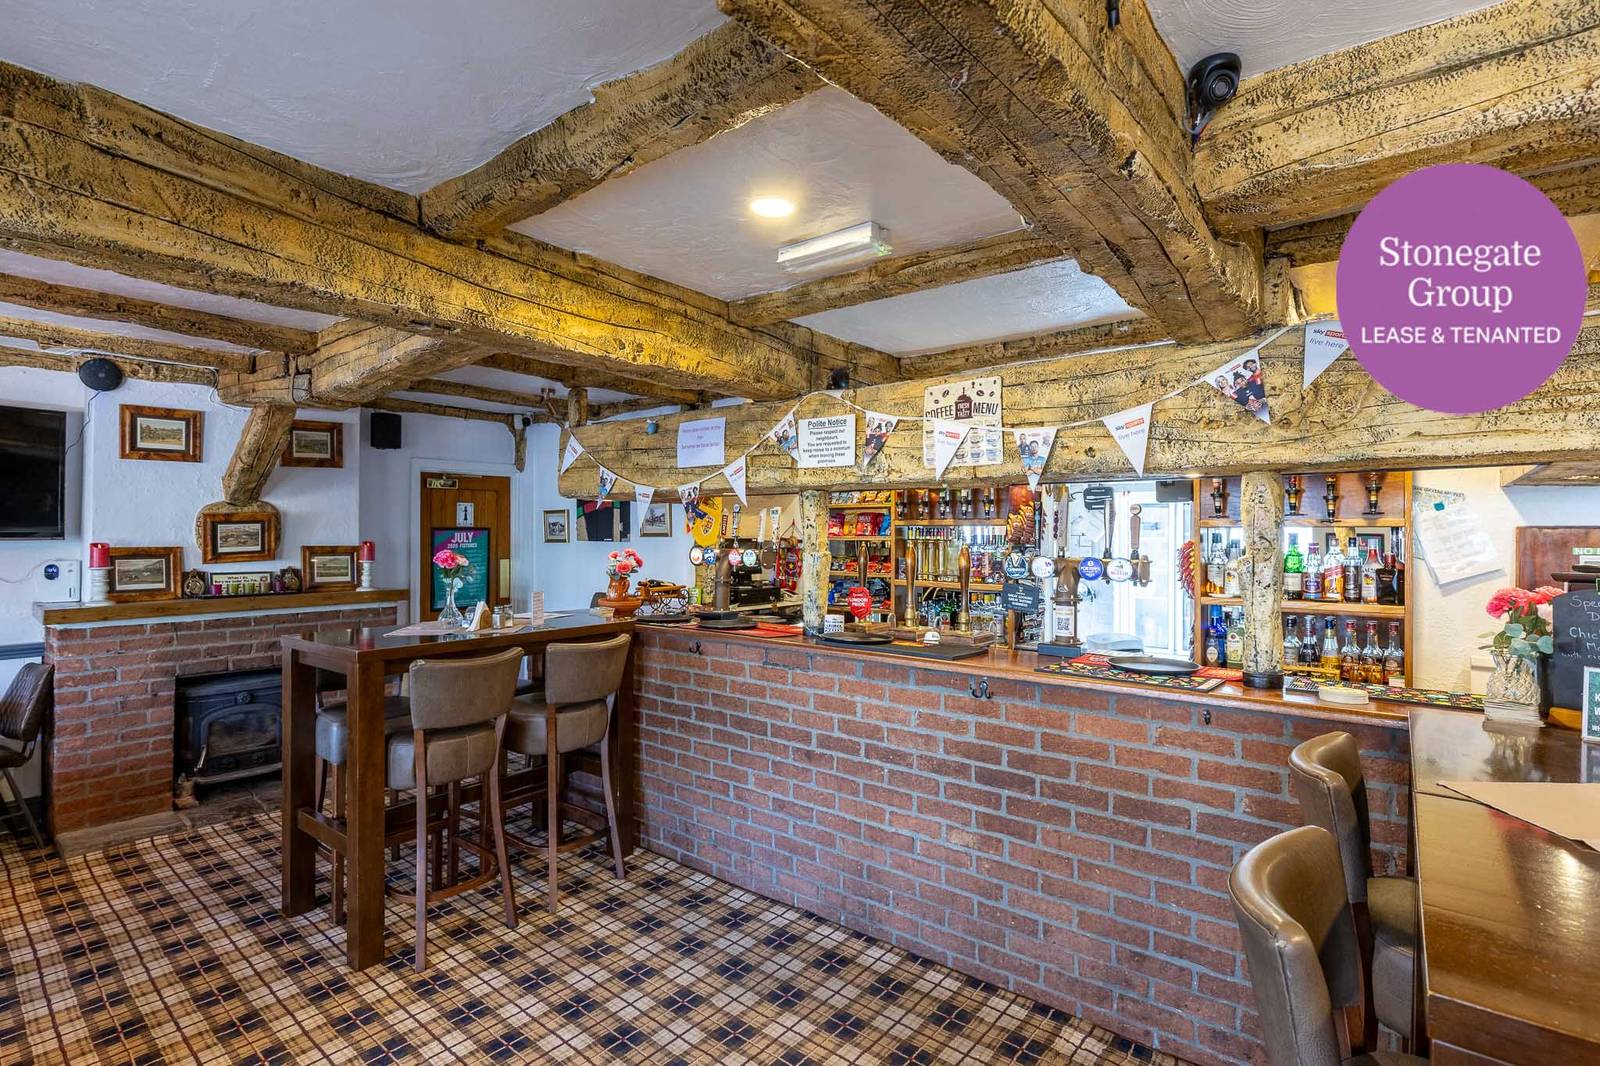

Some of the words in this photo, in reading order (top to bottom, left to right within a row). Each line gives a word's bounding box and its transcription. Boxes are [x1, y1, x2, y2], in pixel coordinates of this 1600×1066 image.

[1325, 341, 1344, 349] here
[925, 405, 954, 418] COFFEE
[973, 402, 998, 415] MENU
[451, 532, 473, 543] JULY
[1570, 626, 1600, 640] Chic
